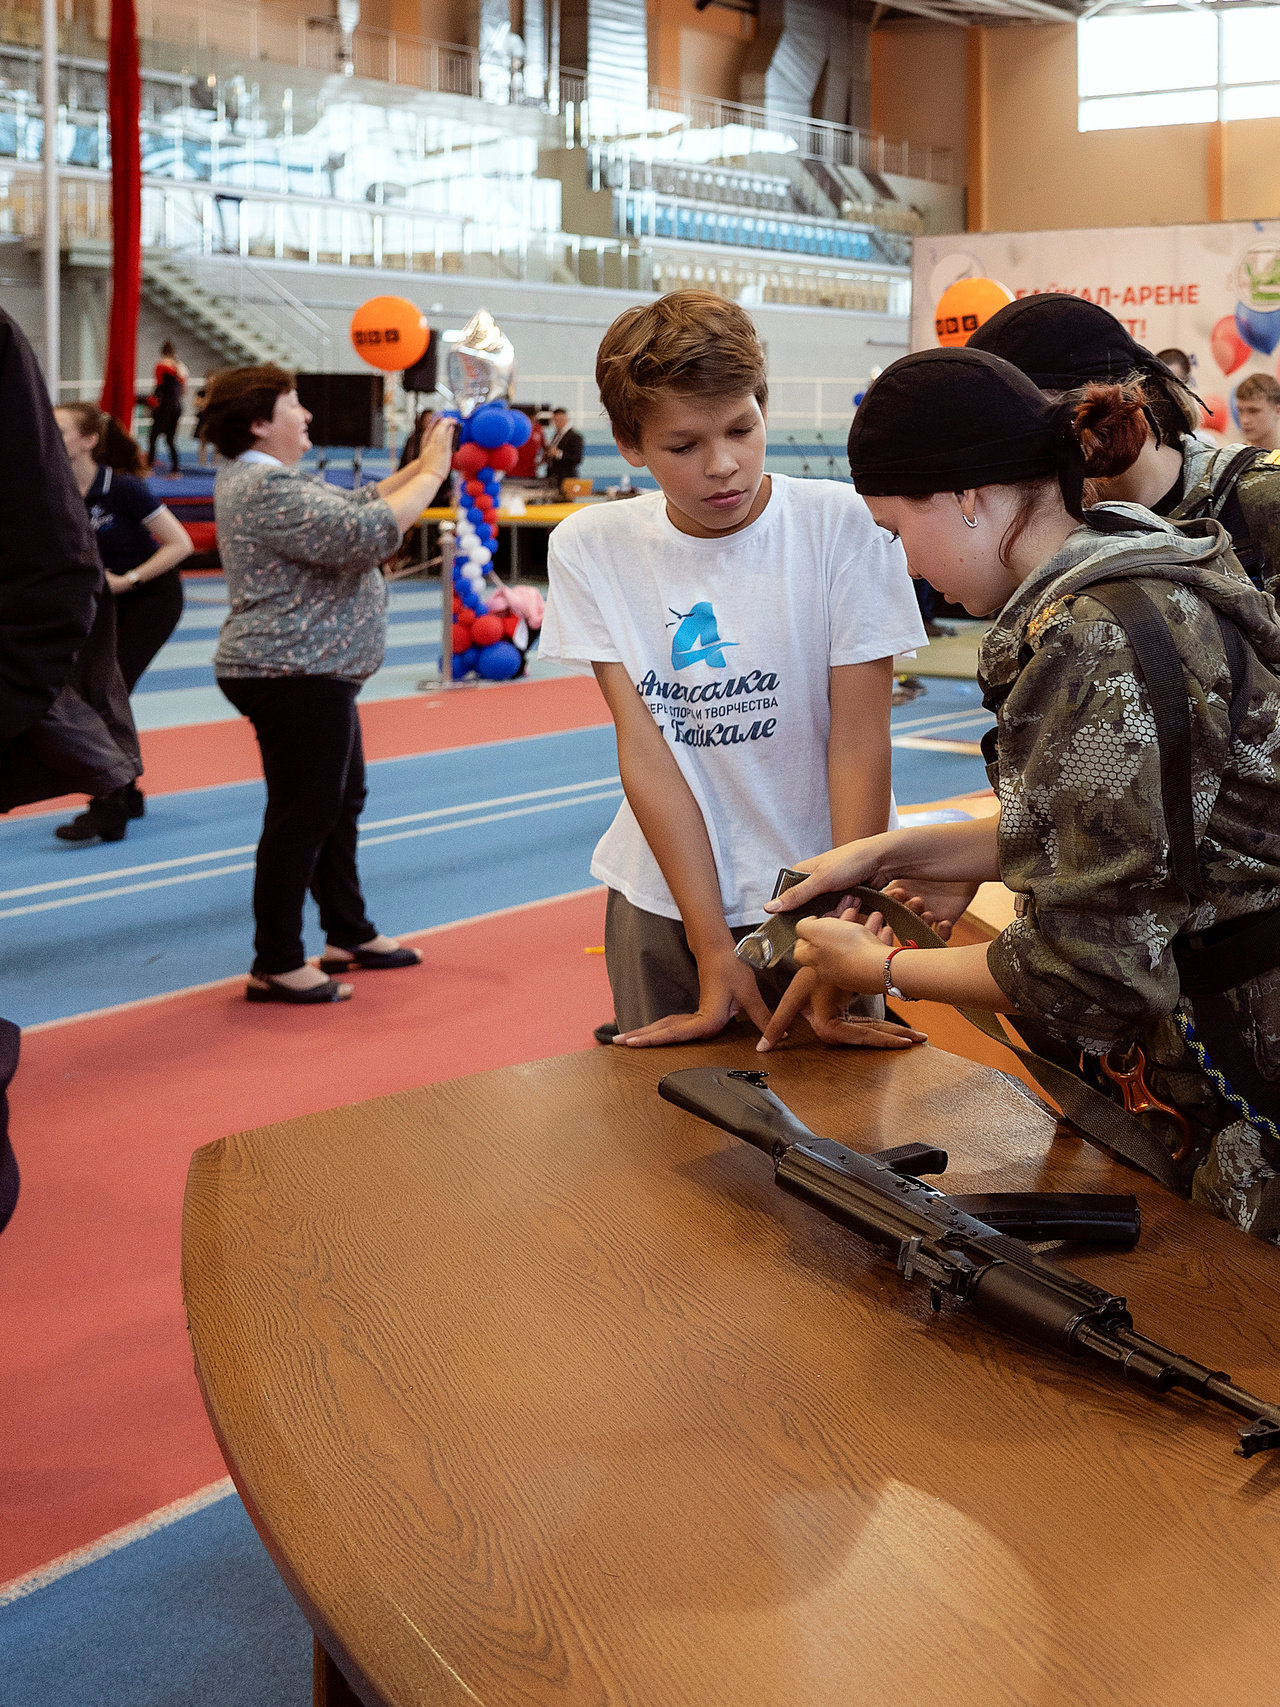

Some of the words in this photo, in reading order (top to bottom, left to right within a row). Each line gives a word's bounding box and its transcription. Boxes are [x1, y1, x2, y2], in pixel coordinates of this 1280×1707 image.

[1016, 283, 1199, 306] БАЛ-АРЕНЕ
[705, 696, 778, 719] ТВОРЧЕСТВА
[671, 717, 777, 747] Байкале
